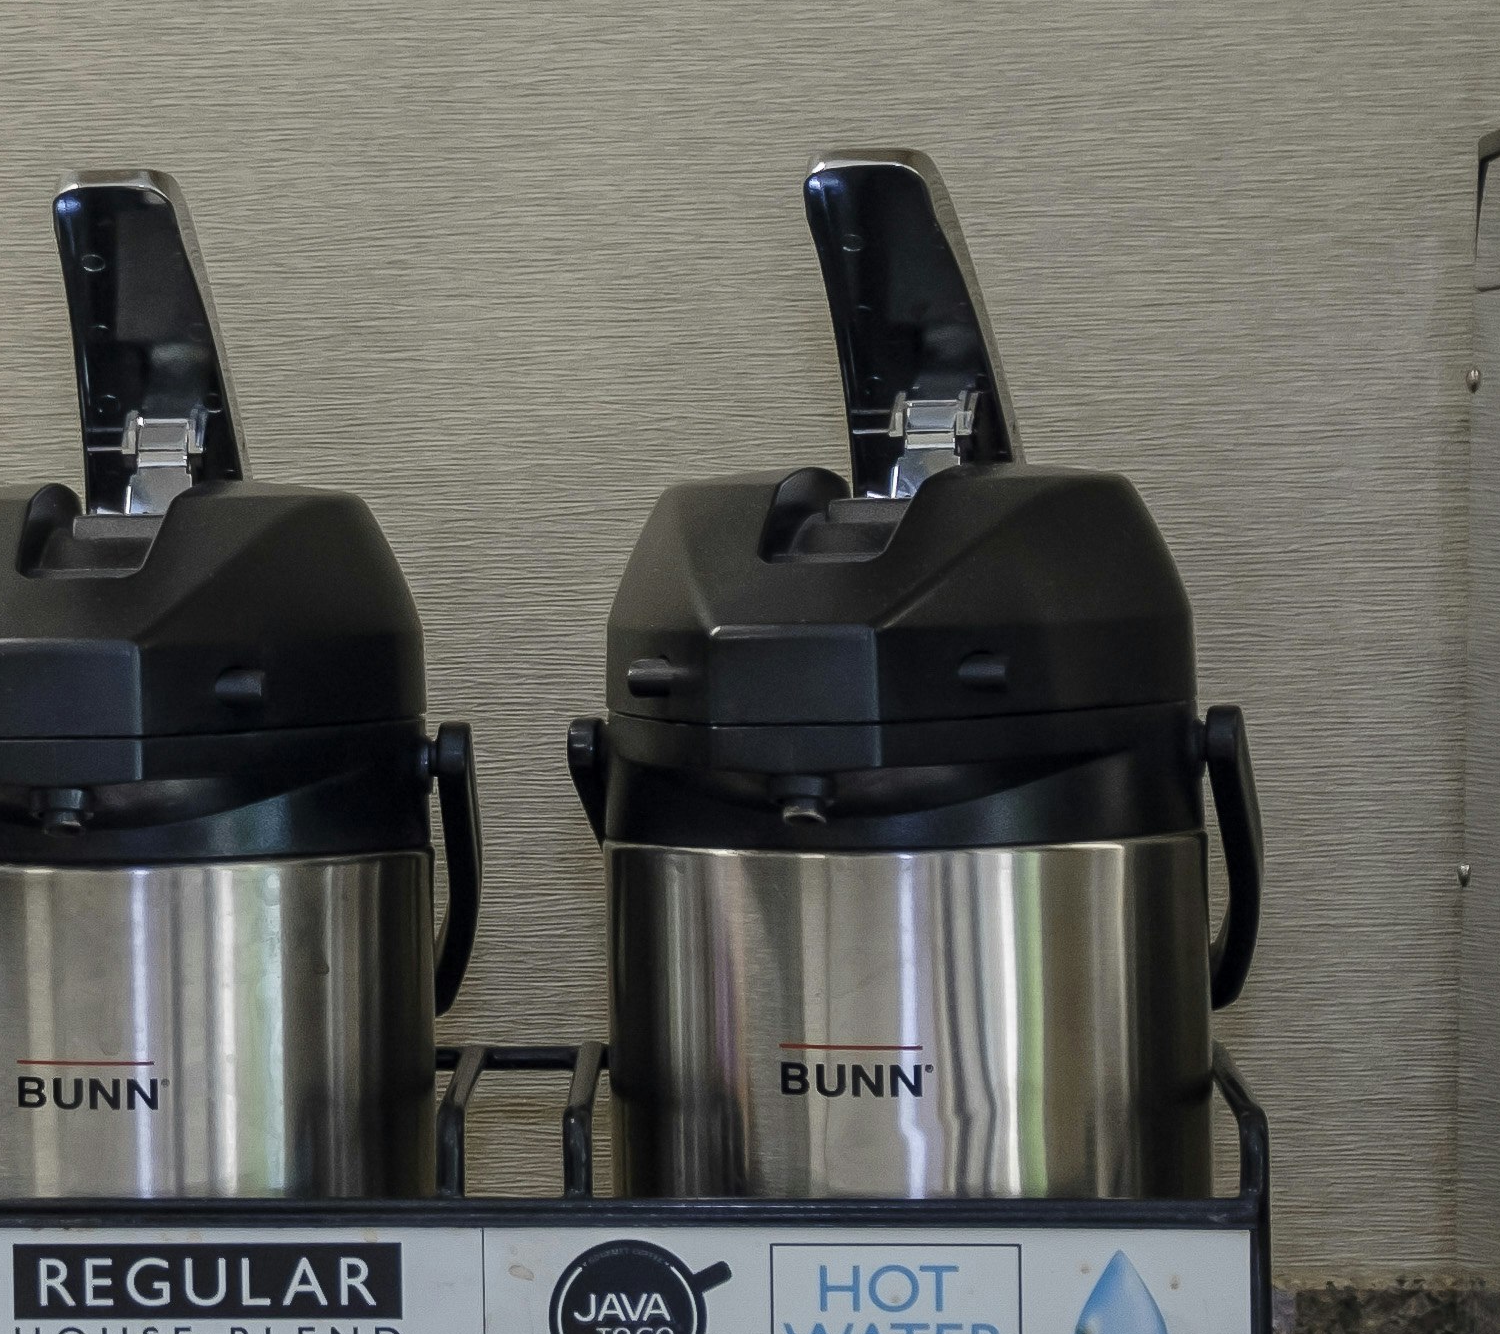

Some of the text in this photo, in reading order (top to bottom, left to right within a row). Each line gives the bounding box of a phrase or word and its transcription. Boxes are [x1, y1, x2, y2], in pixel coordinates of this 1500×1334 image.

[18, 1076, 159, 1110] BUNN
[780, 1061, 923, 1098] BUNN
[36, 1256, 377, 1307] REGULAR
[818, 1265, 959, 1313] HOT
[573, 1293, 671, 1322] JAVA
